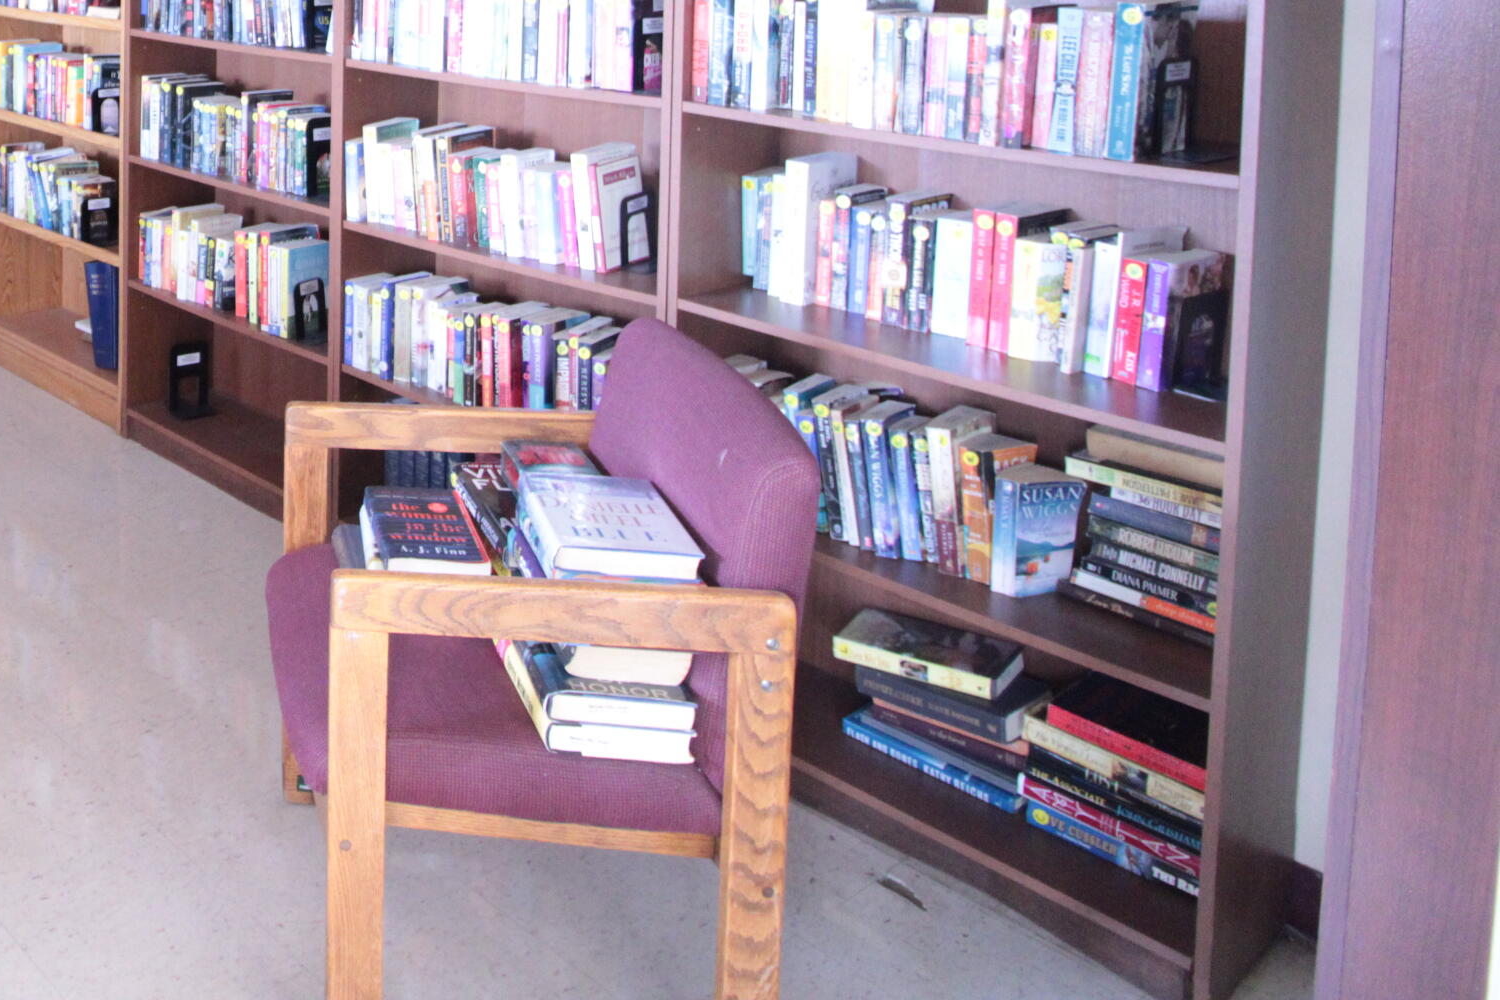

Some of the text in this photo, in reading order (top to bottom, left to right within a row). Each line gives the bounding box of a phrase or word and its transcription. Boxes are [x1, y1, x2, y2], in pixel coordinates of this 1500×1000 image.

[804, 18, 815, 88] imaginary girls
[1058, 35, 1076, 79] LEE CHILD
[1118, 279, 1131, 308] WARD
[392, 503, 420, 511] the
[1022, 486, 1082, 505] SUSAN
[384, 511, 458, 521] woman
[1021, 501, 1079, 519] WIGGS
[434, 545, 468, 556] Finn
[1117, 549, 1157, 577] MICHAEL
[1157, 561, 1206, 590] CONNELLY
[1111, 568, 1180, 602] DIANA PALMER
[567, 678, 670, 699] HONOR
[1067, 822, 1118, 856] CUSSLER
